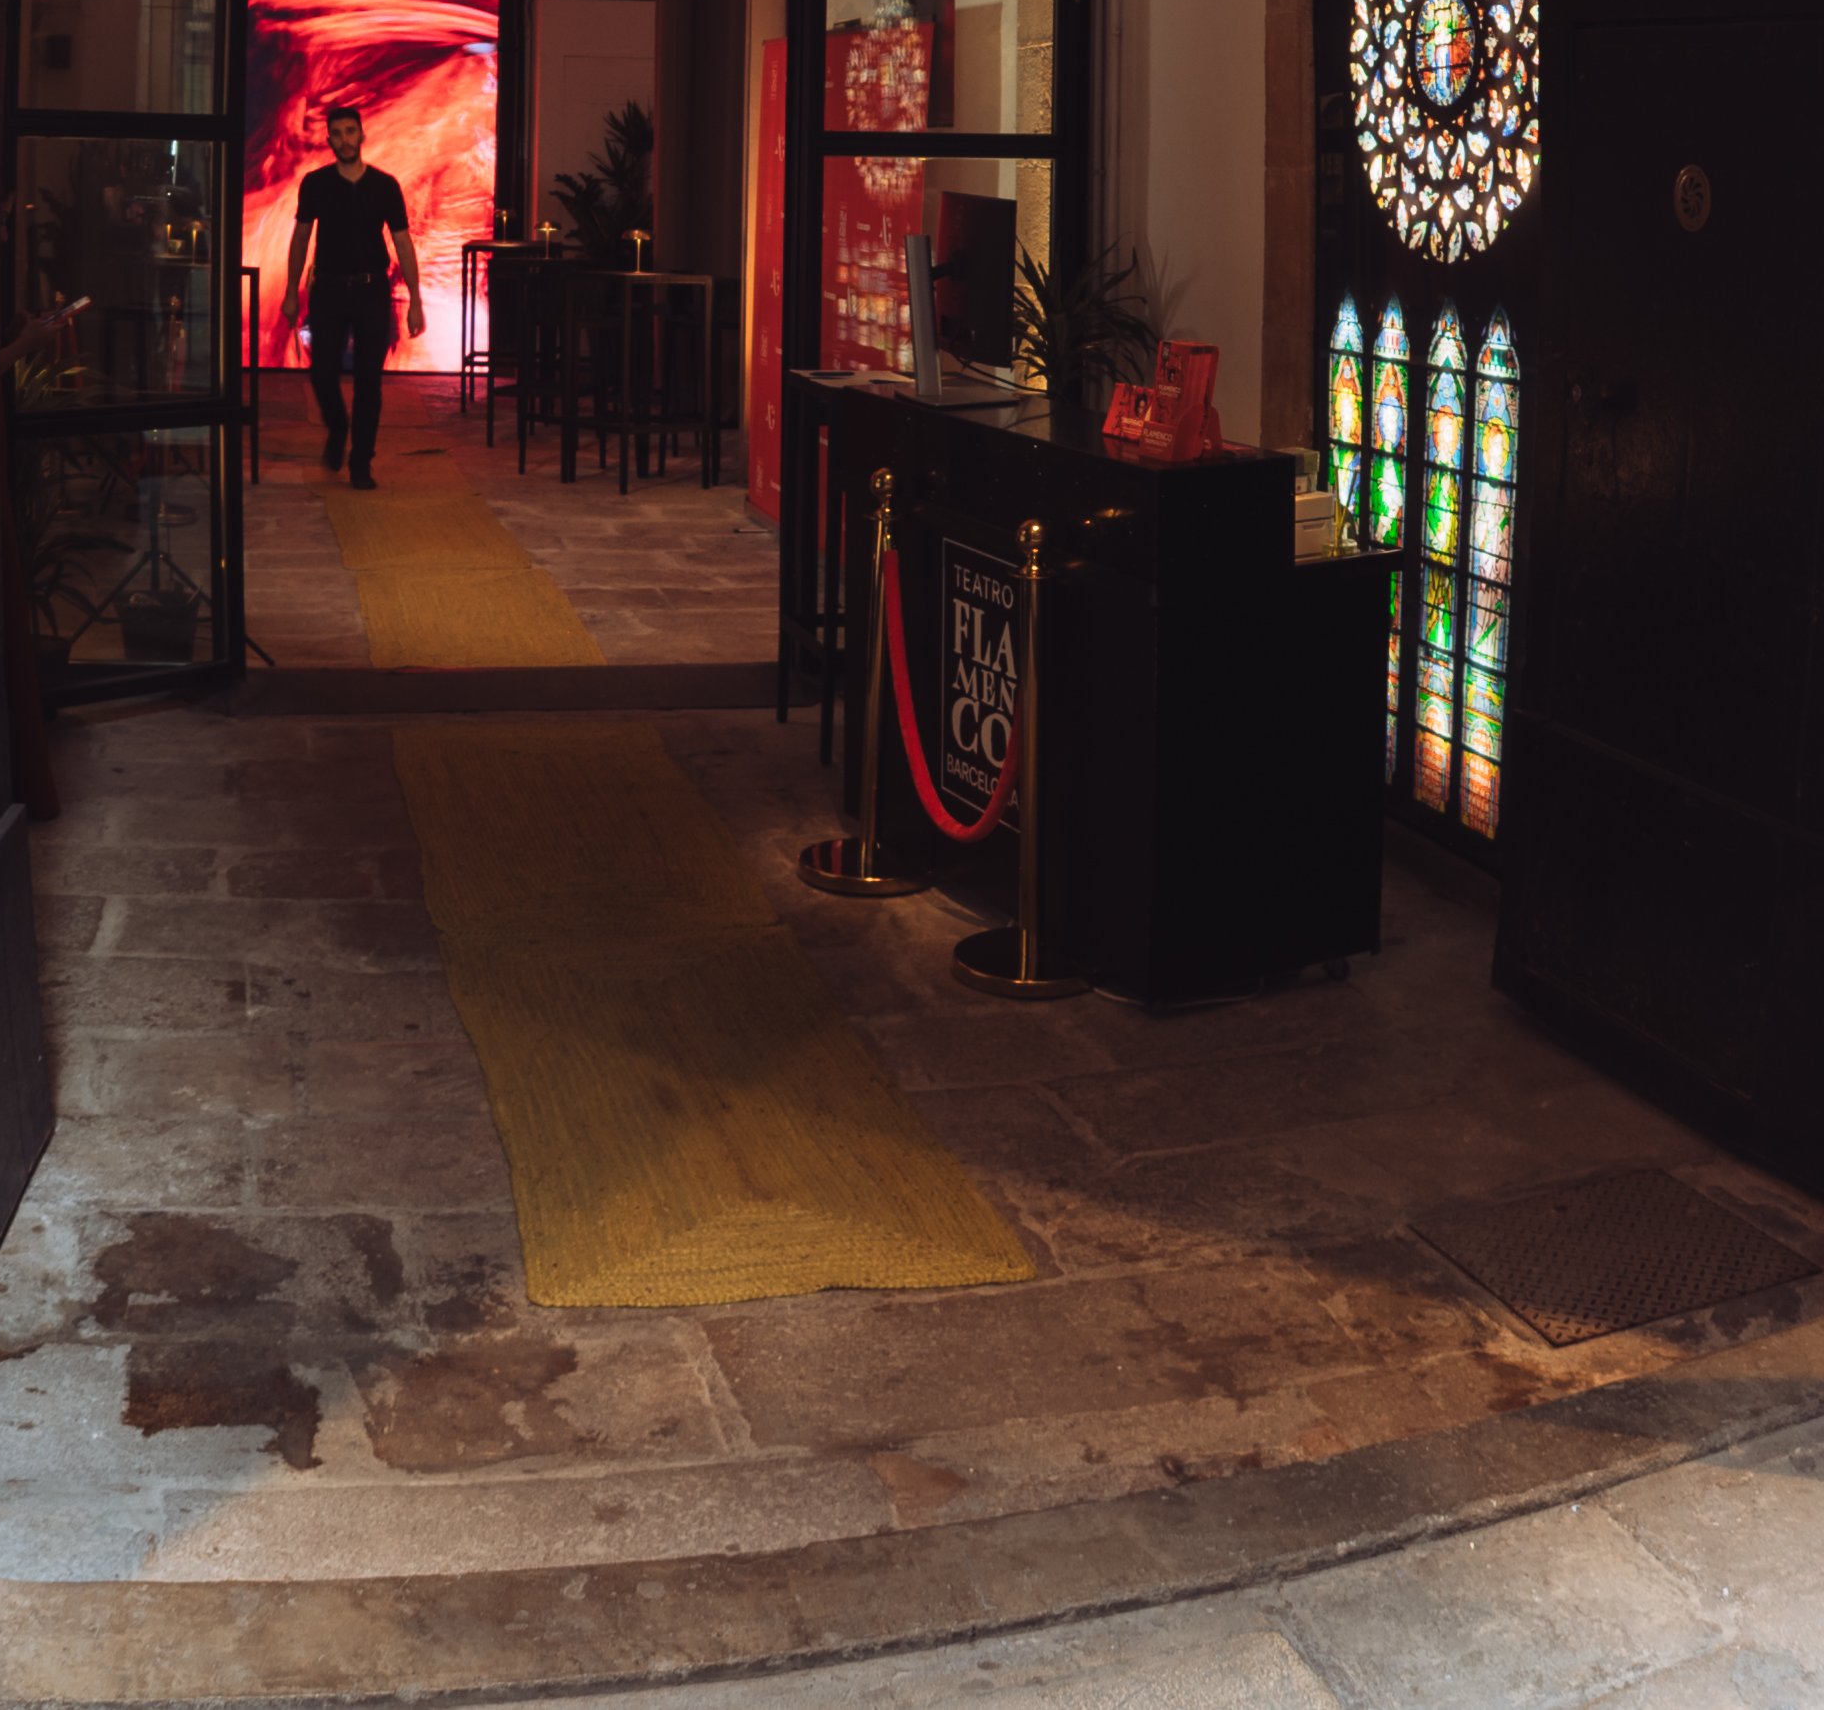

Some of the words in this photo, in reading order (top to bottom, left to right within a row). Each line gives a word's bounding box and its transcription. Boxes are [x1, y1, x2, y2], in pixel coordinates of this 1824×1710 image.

[954, 564, 1014, 610] TEATRO
[952, 598, 1018, 680] FLA
[952, 658, 1017, 716] MEN
[947, 752, 1020, 811] BARCELOA
